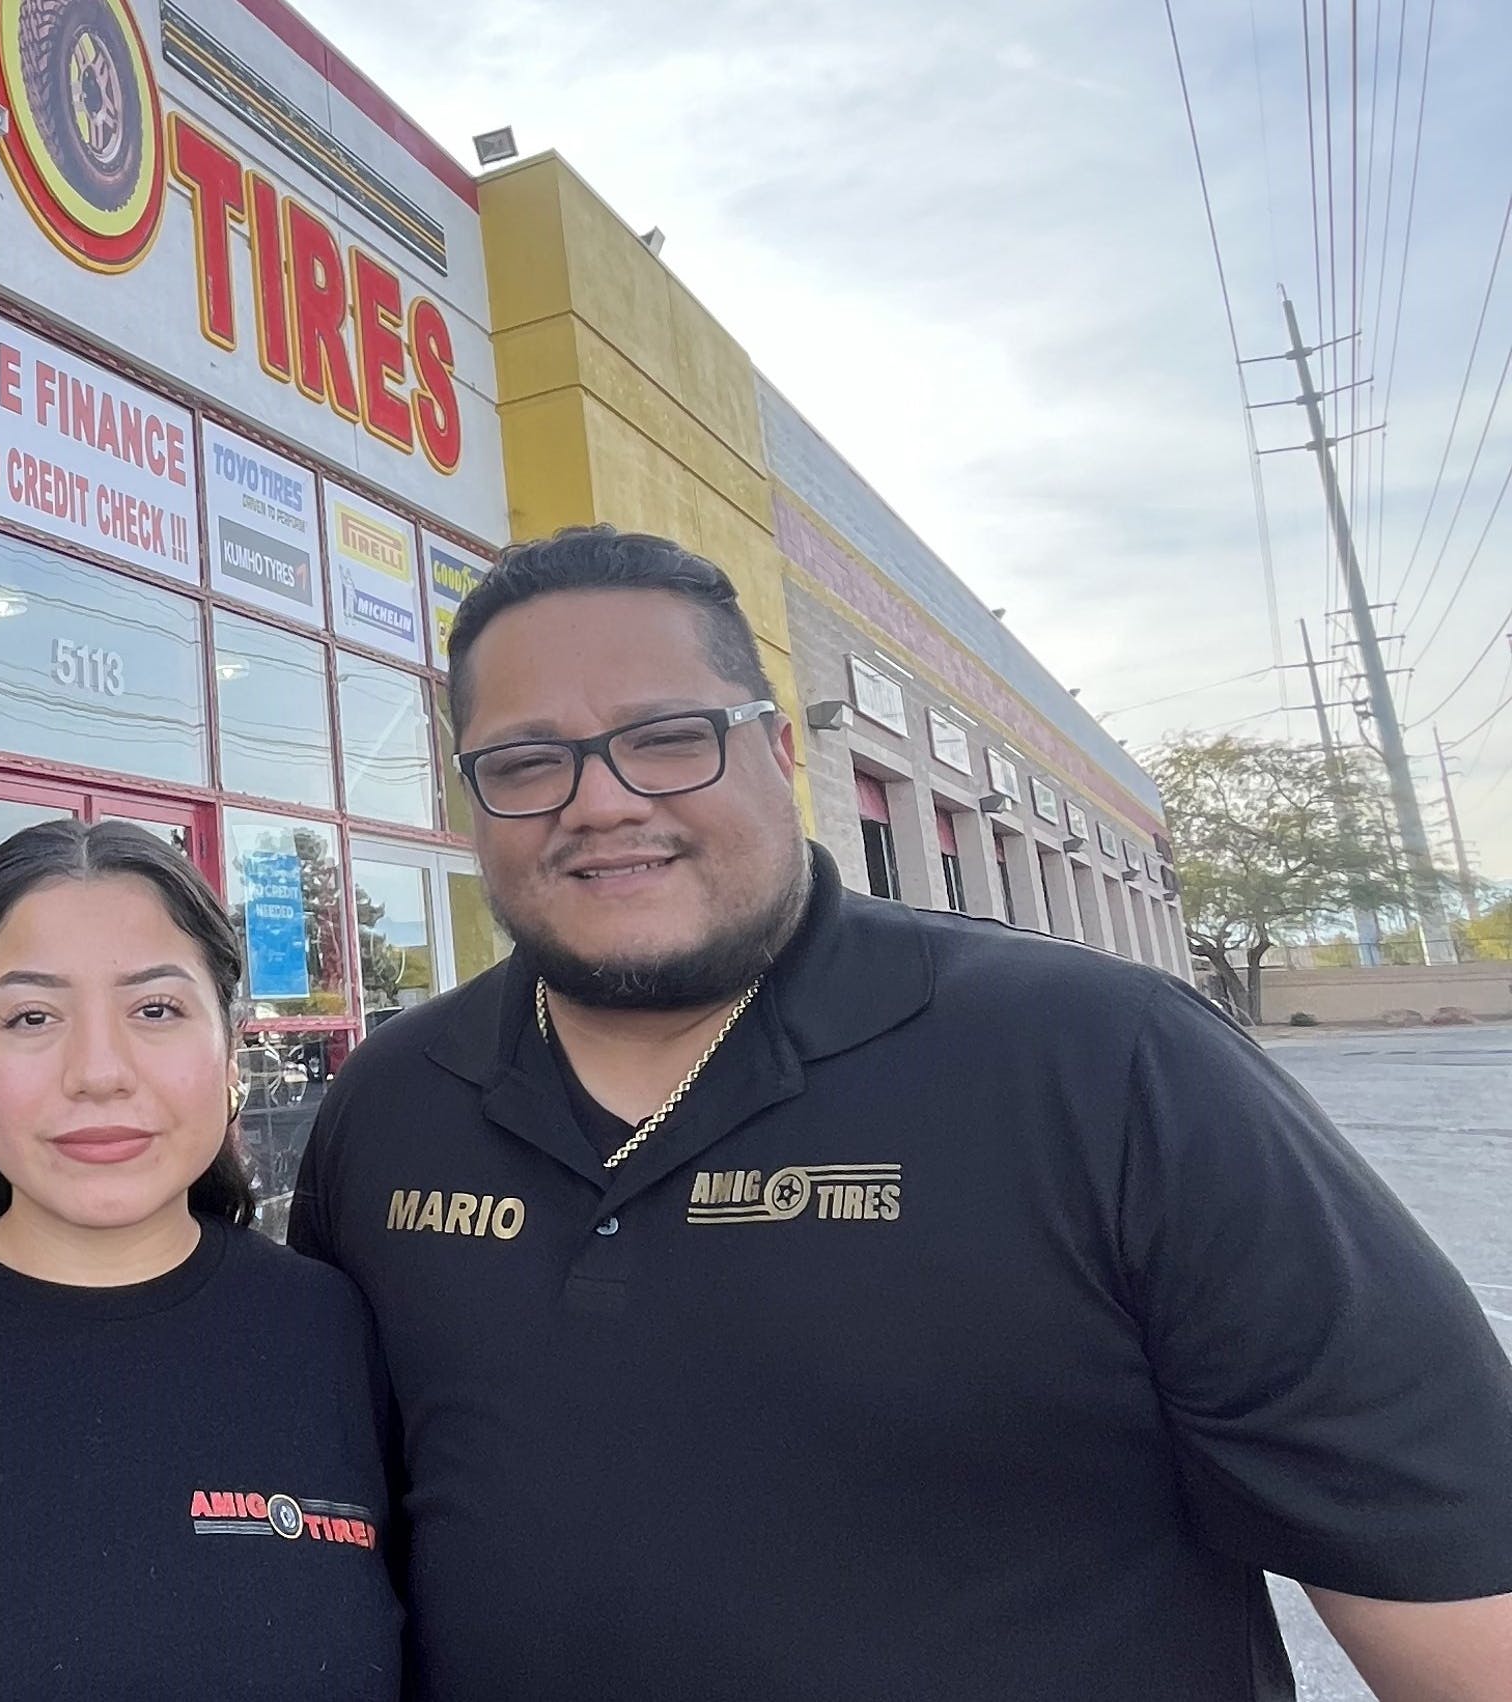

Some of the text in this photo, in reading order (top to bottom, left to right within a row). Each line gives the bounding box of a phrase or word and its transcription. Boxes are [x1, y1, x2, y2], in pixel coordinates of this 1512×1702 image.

[168, 111, 462, 475] TIRES
[36, 360, 187, 487] FINANCE
[8, 448, 89, 527] CREDIT
[96, 484, 167, 557] CHECK
[341, 512, 404, 572] PIRELLI
[357, 597, 412, 632] MICHELIN
[52, 638, 125, 697] 5113
[255, 903, 294, 919] NEEDED
[387, 1189, 526, 1241] MARIO
[817, 1184, 901, 1221] TIRES
